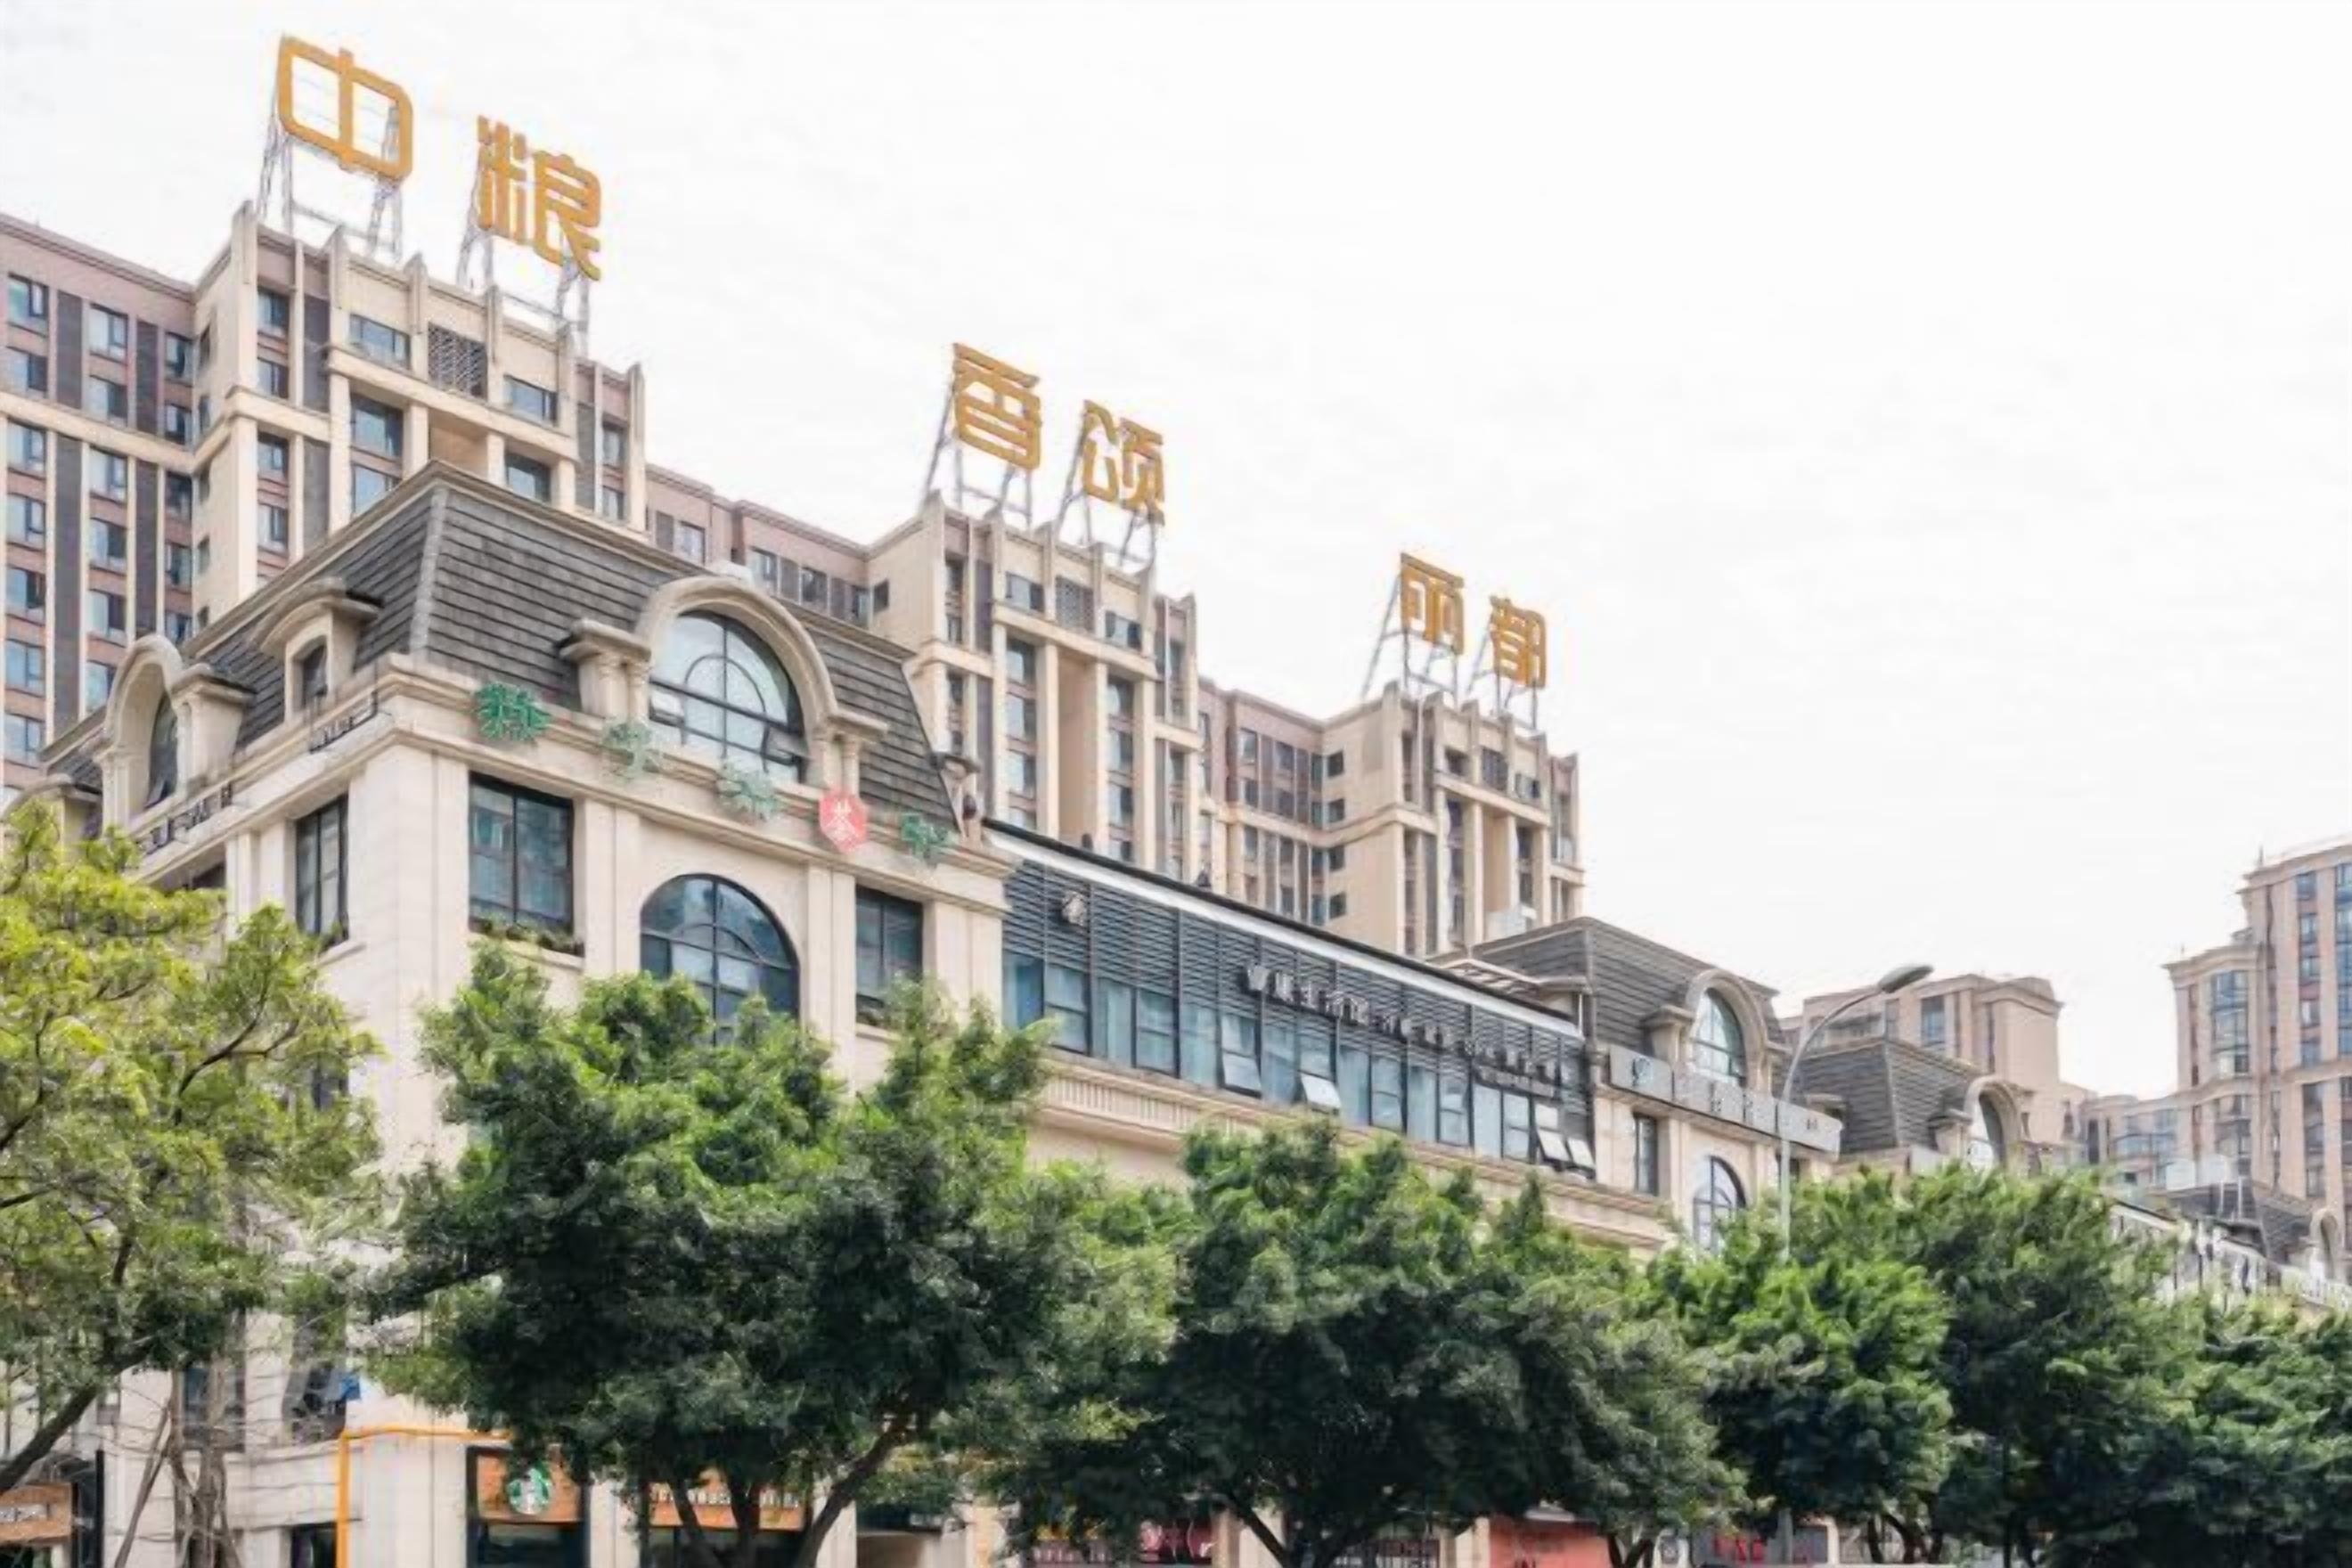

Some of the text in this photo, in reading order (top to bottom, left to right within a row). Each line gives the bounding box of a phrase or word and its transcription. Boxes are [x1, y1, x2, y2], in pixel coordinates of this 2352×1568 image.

[276, 37, 600, 280] 中粮
[952, 343, 1165, 525] 香颂
[1401, 553, 1546, 688] 丽都
